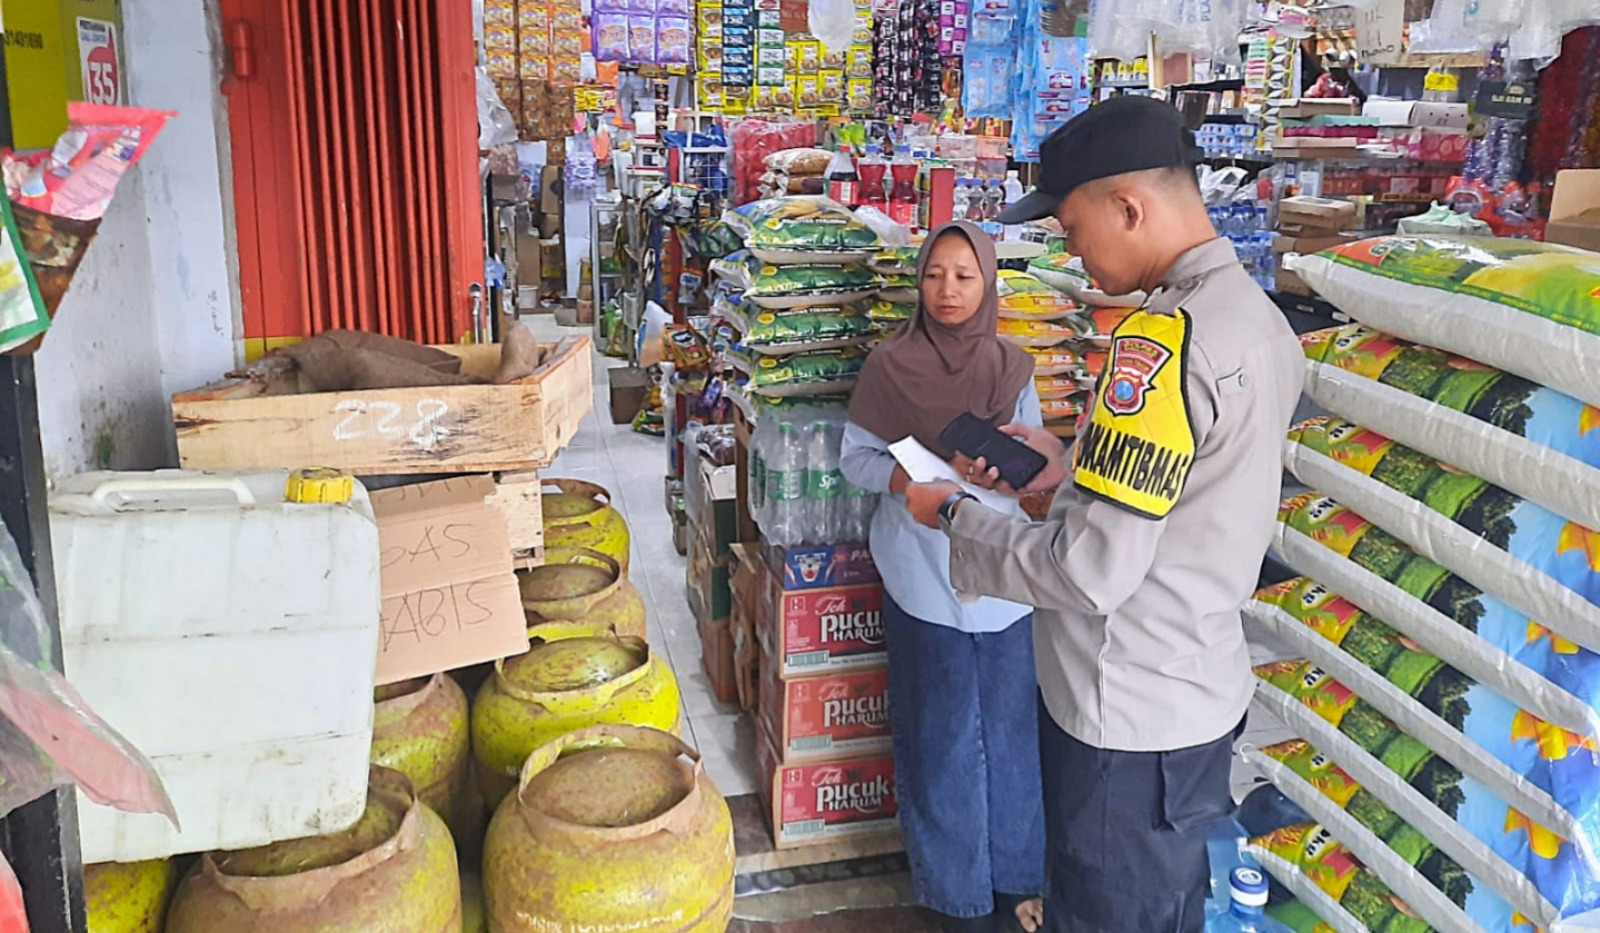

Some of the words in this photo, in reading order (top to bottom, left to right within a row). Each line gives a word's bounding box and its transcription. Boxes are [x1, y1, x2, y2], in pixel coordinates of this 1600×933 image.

[333, 398, 450, 452] 228
[815, 595, 847, 615] Teh
[818, 681, 849, 702] Teh
[811, 767, 843, 787] Teh
[829, 796, 882, 812] HARUM
